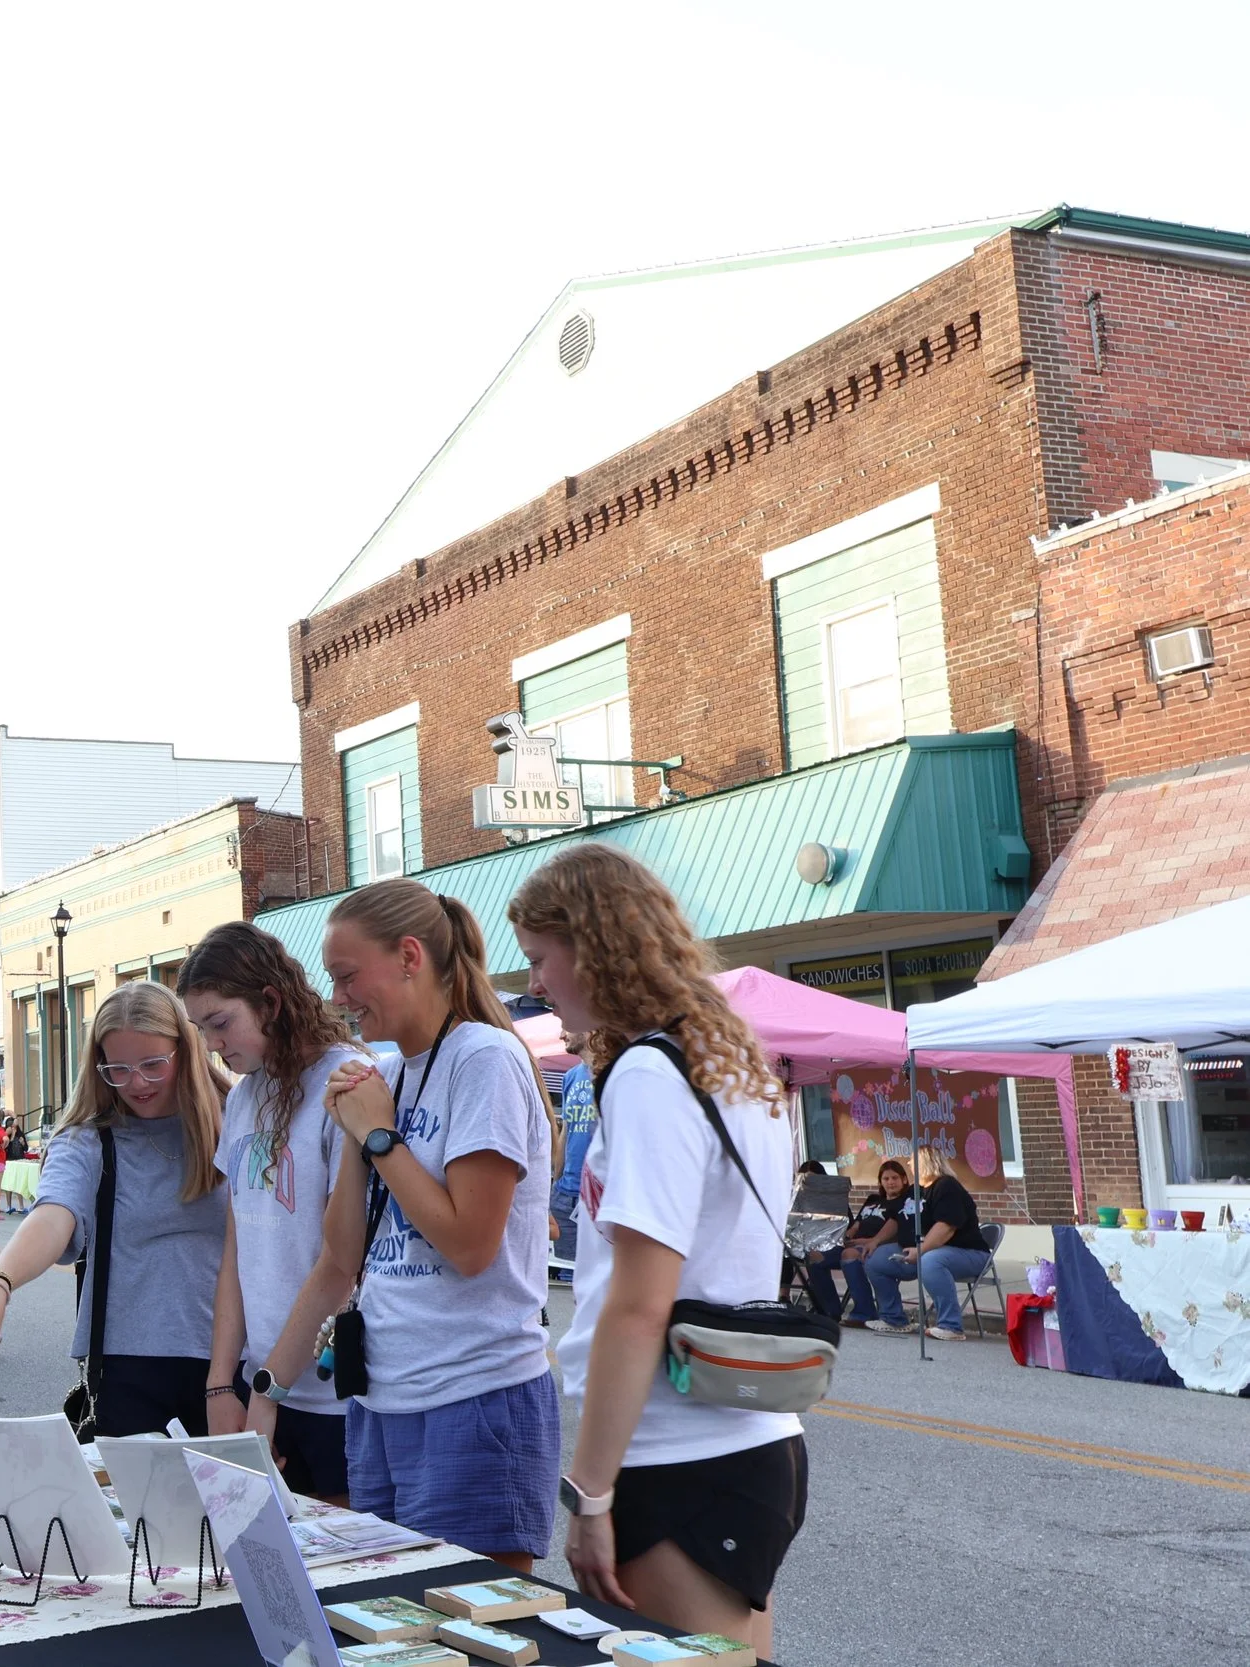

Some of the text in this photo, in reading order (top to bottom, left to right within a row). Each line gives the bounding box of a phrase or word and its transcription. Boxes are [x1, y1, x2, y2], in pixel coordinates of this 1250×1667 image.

[521, 747, 546, 756] 1925
[528, 772, 544, 780] THE
[517, 781, 555, 789] HISTORIC
[503, 790, 570, 810] SIMS
[494, 811, 579, 821] BUILDING
[800, 963, 881, 986] SANDWICHES
[904, 957, 933, 977] SODA
[1137, 1060, 1151, 1073] BY
[565, 1105, 596, 1122] STAR
[915, 1089, 956, 1125] Ball
